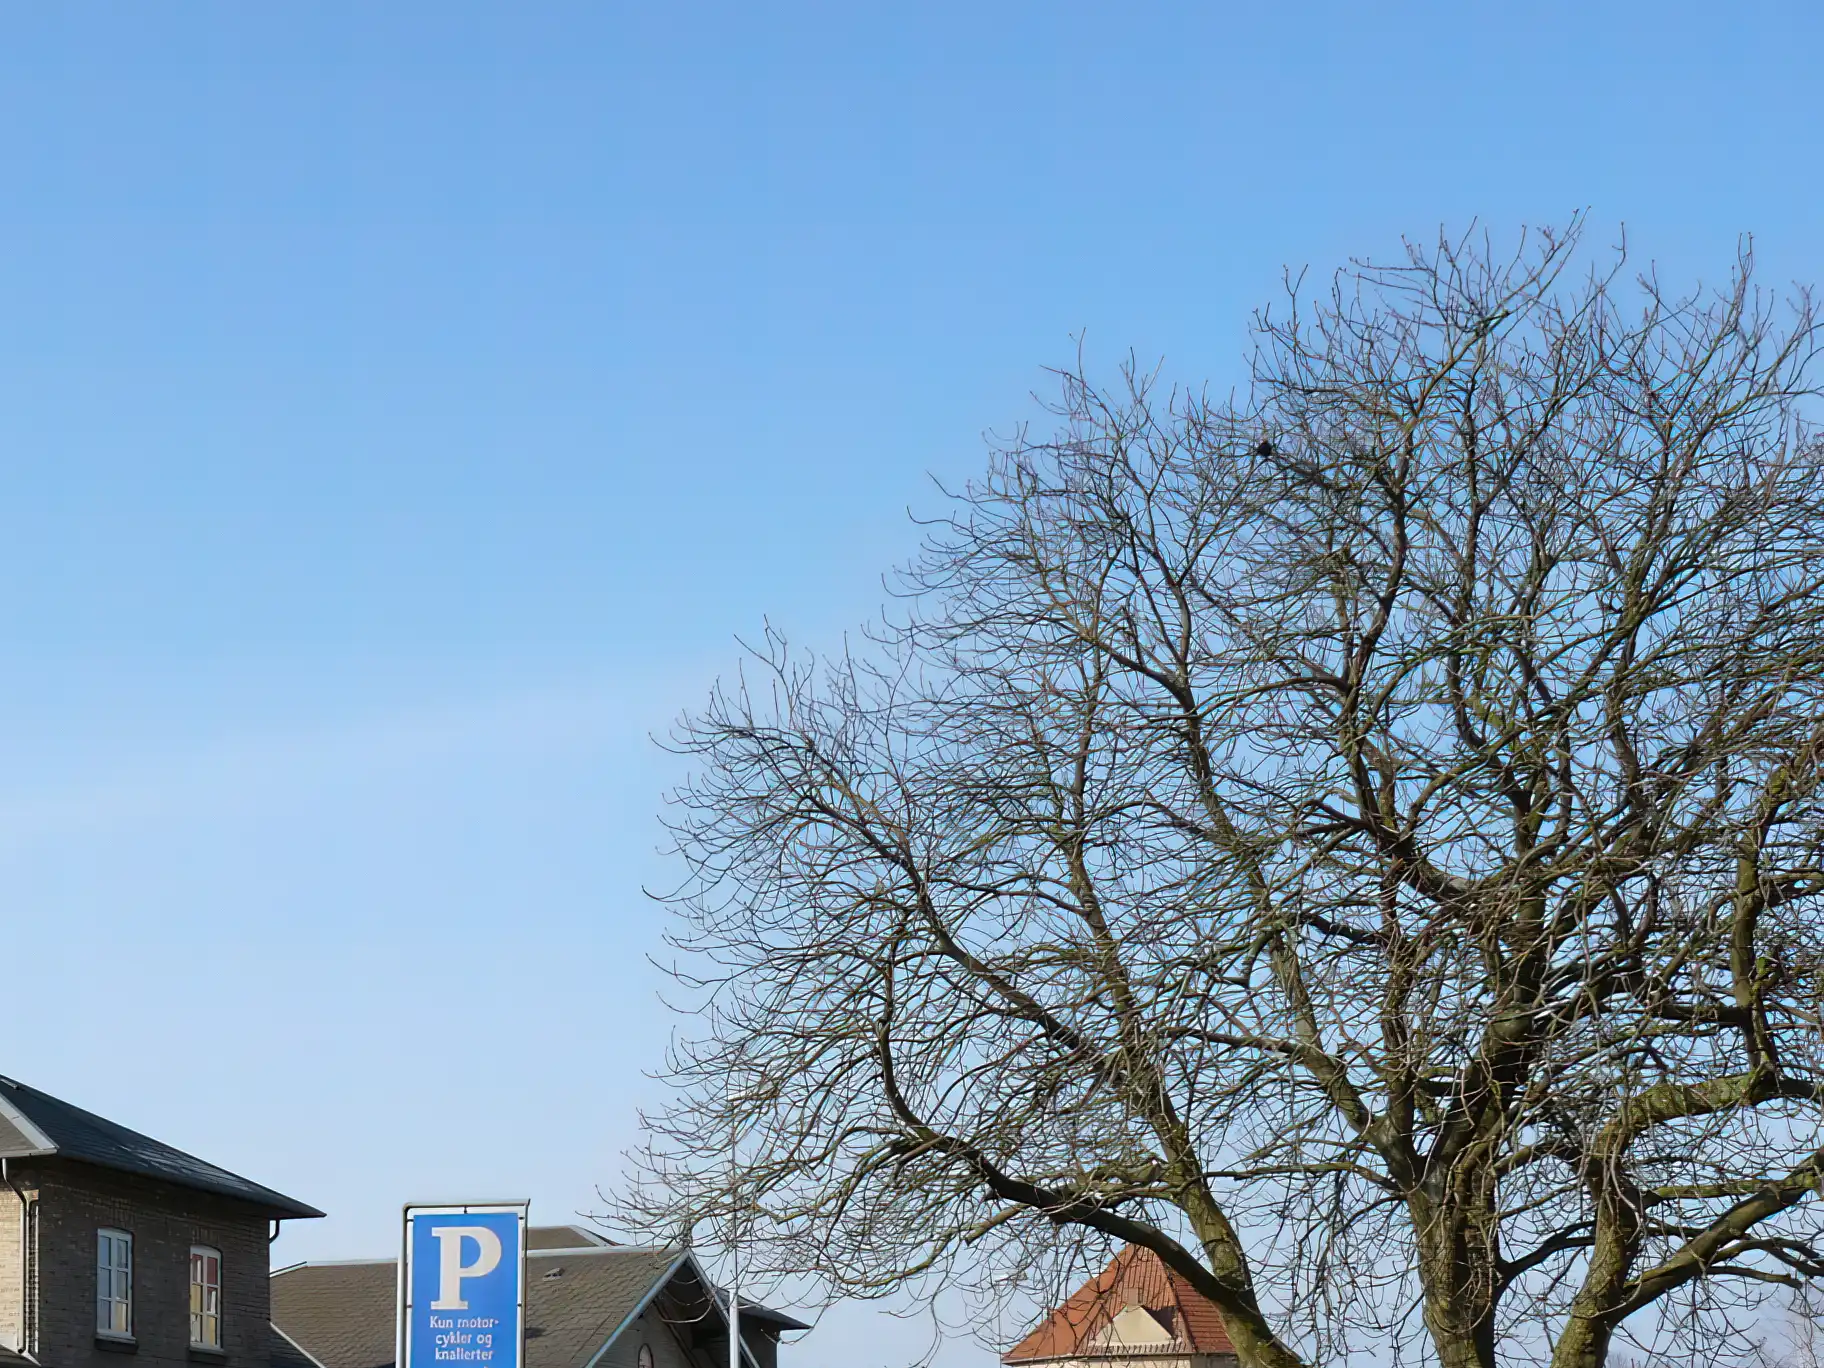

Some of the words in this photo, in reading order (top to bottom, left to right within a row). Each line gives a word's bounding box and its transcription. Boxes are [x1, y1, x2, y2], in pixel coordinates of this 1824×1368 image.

[430, 1226, 502, 1310] P
[430, 1316, 453, 1328] Kun
[457, 1316, 499, 1328] motor-
[435, 1331, 472, 1348] cykler
[477, 1334, 492, 1348] og
[435, 1347, 494, 1361] knallerter
